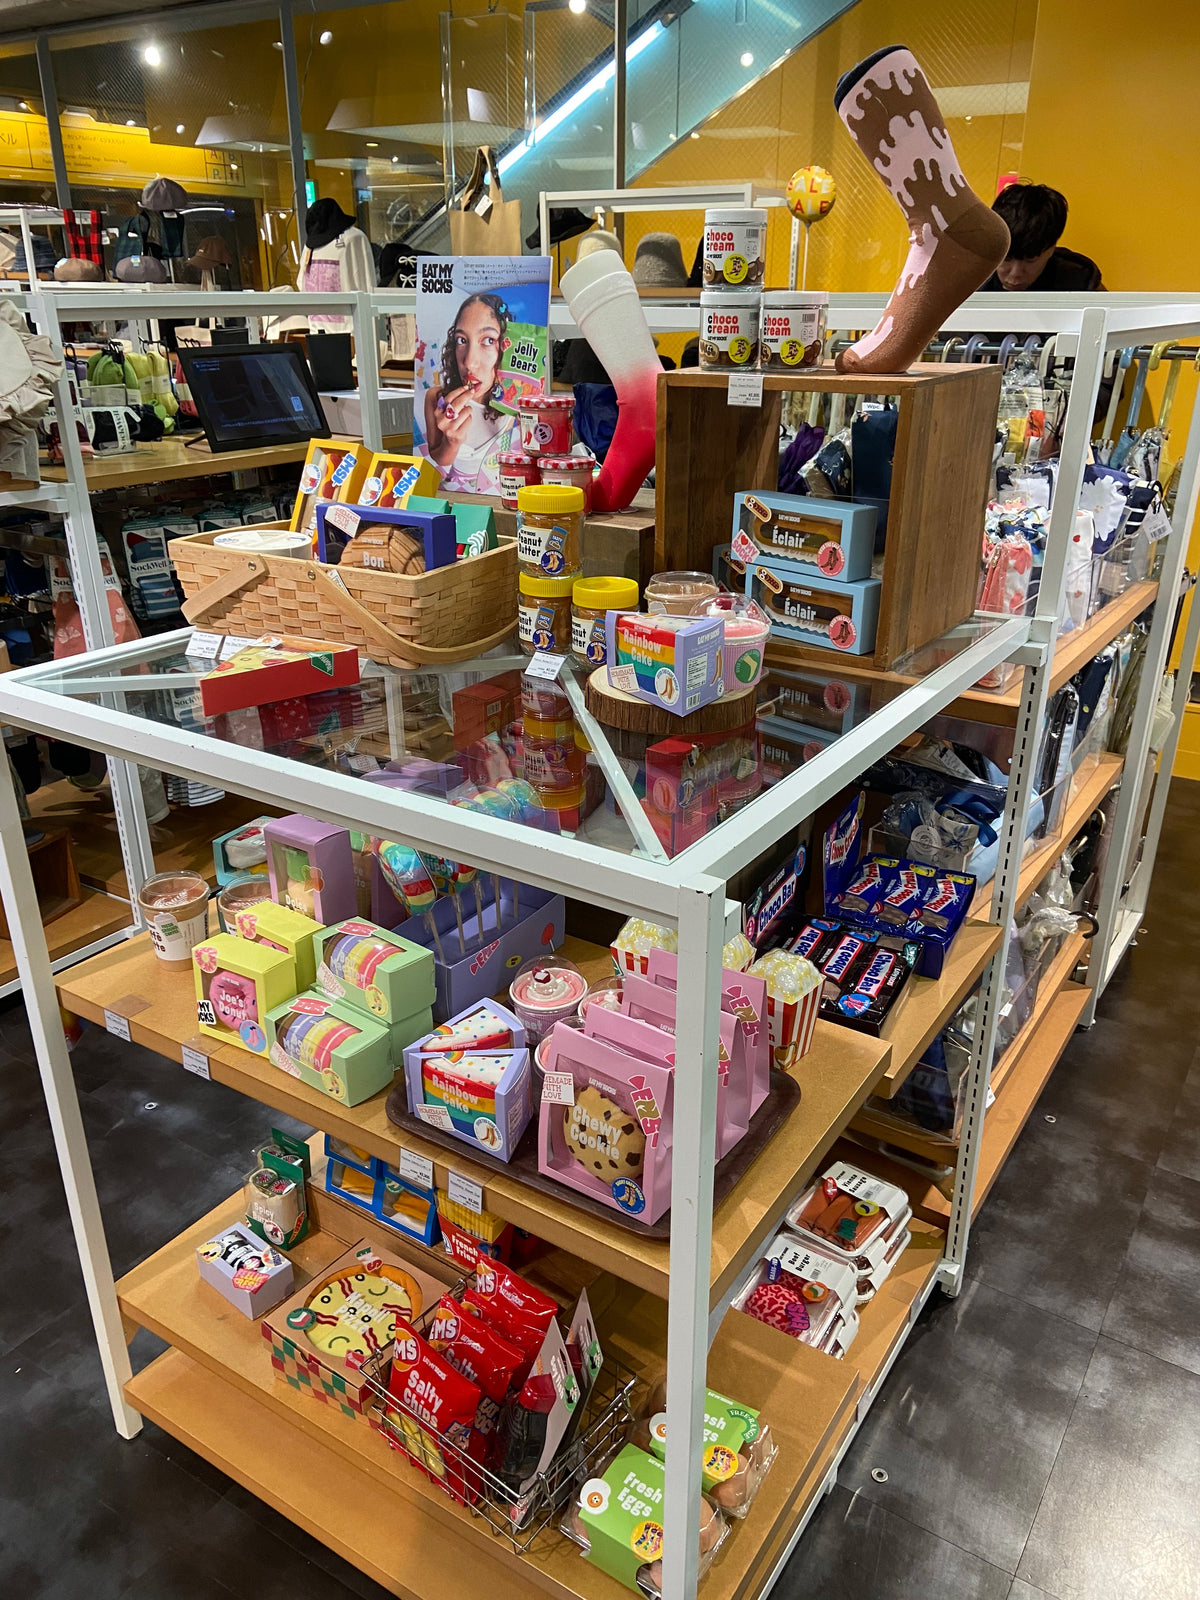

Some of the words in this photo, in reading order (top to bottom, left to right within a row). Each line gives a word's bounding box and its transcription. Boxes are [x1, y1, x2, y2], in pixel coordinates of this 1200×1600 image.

[706, 229, 734, 241] choco
[706, 242, 735, 252] cream
[422, 264, 439, 278] EAT
[439, 264, 454, 278] MY
[422, 280, 453, 293] SOCKS
[708, 312, 739, 324] choco
[764, 315, 790, 326] choco
[708, 325, 740, 334] cream
[764, 326, 791, 336] cream
[514, 341, 539, 361] Jelly
[510, 355, 538, 374] Bears
[772, 525, 805, 549] Éclair
[731, 539, 753, 563] SOCKS
[745, 542, 758, 557] MY
[130, 560, 167, 573] SockWell
[784, 597, 817, 620] Éclair
[624, 628, 662, 654] Rainbow
[631, 647, 653, 667] Cake
[848, 877, 874, 894] Choco
[887, 888, 914, 904] Choco
[902, 871, 917, 891] Crush
[759, 895, 782, 932] Choco
[781, 880, 795, 905] Bar
[925, 894, 951, 911] Choco
[801, 929, 822, 944] Bar
[825, 951, 849, 975] Choco
[840, 939, 861, 956] Bar
[868, 953, 893, 977] Choco
[863, 974, 881, 992] Bar
[199, 1001, 210, 1012] MY
[220, 989, 244, 1008] Joe's
[218, 1001, 247, 1020] Donut
[432, 1074, 479, 1105] Rainbow
[543, 1092, 562, 1100] LOVE
[443, 1092, 470, 1114] Cake
[572, 1104, 623, 1146] Chewy
[570, 1123, 620, 1160] Cookie
[451, 1234, 479, 1257] French
[455, 1245, 476, 1265] Fries
[356, 1247, 383, 1272] EMS
[787, 1251, 801, 1266] Beef
[795, 1254, 811, 1272] Burger
[475, 1272, 495, 1294] MS
[446, 1347, 478, 1383] Salty
[407, 1369, 444, 1414] Salty
[403, 1387, 438, 1428] Chips
[623, 1471, 663, 1504] Fresh
[617, 1486, 653, 1518] Eggs
